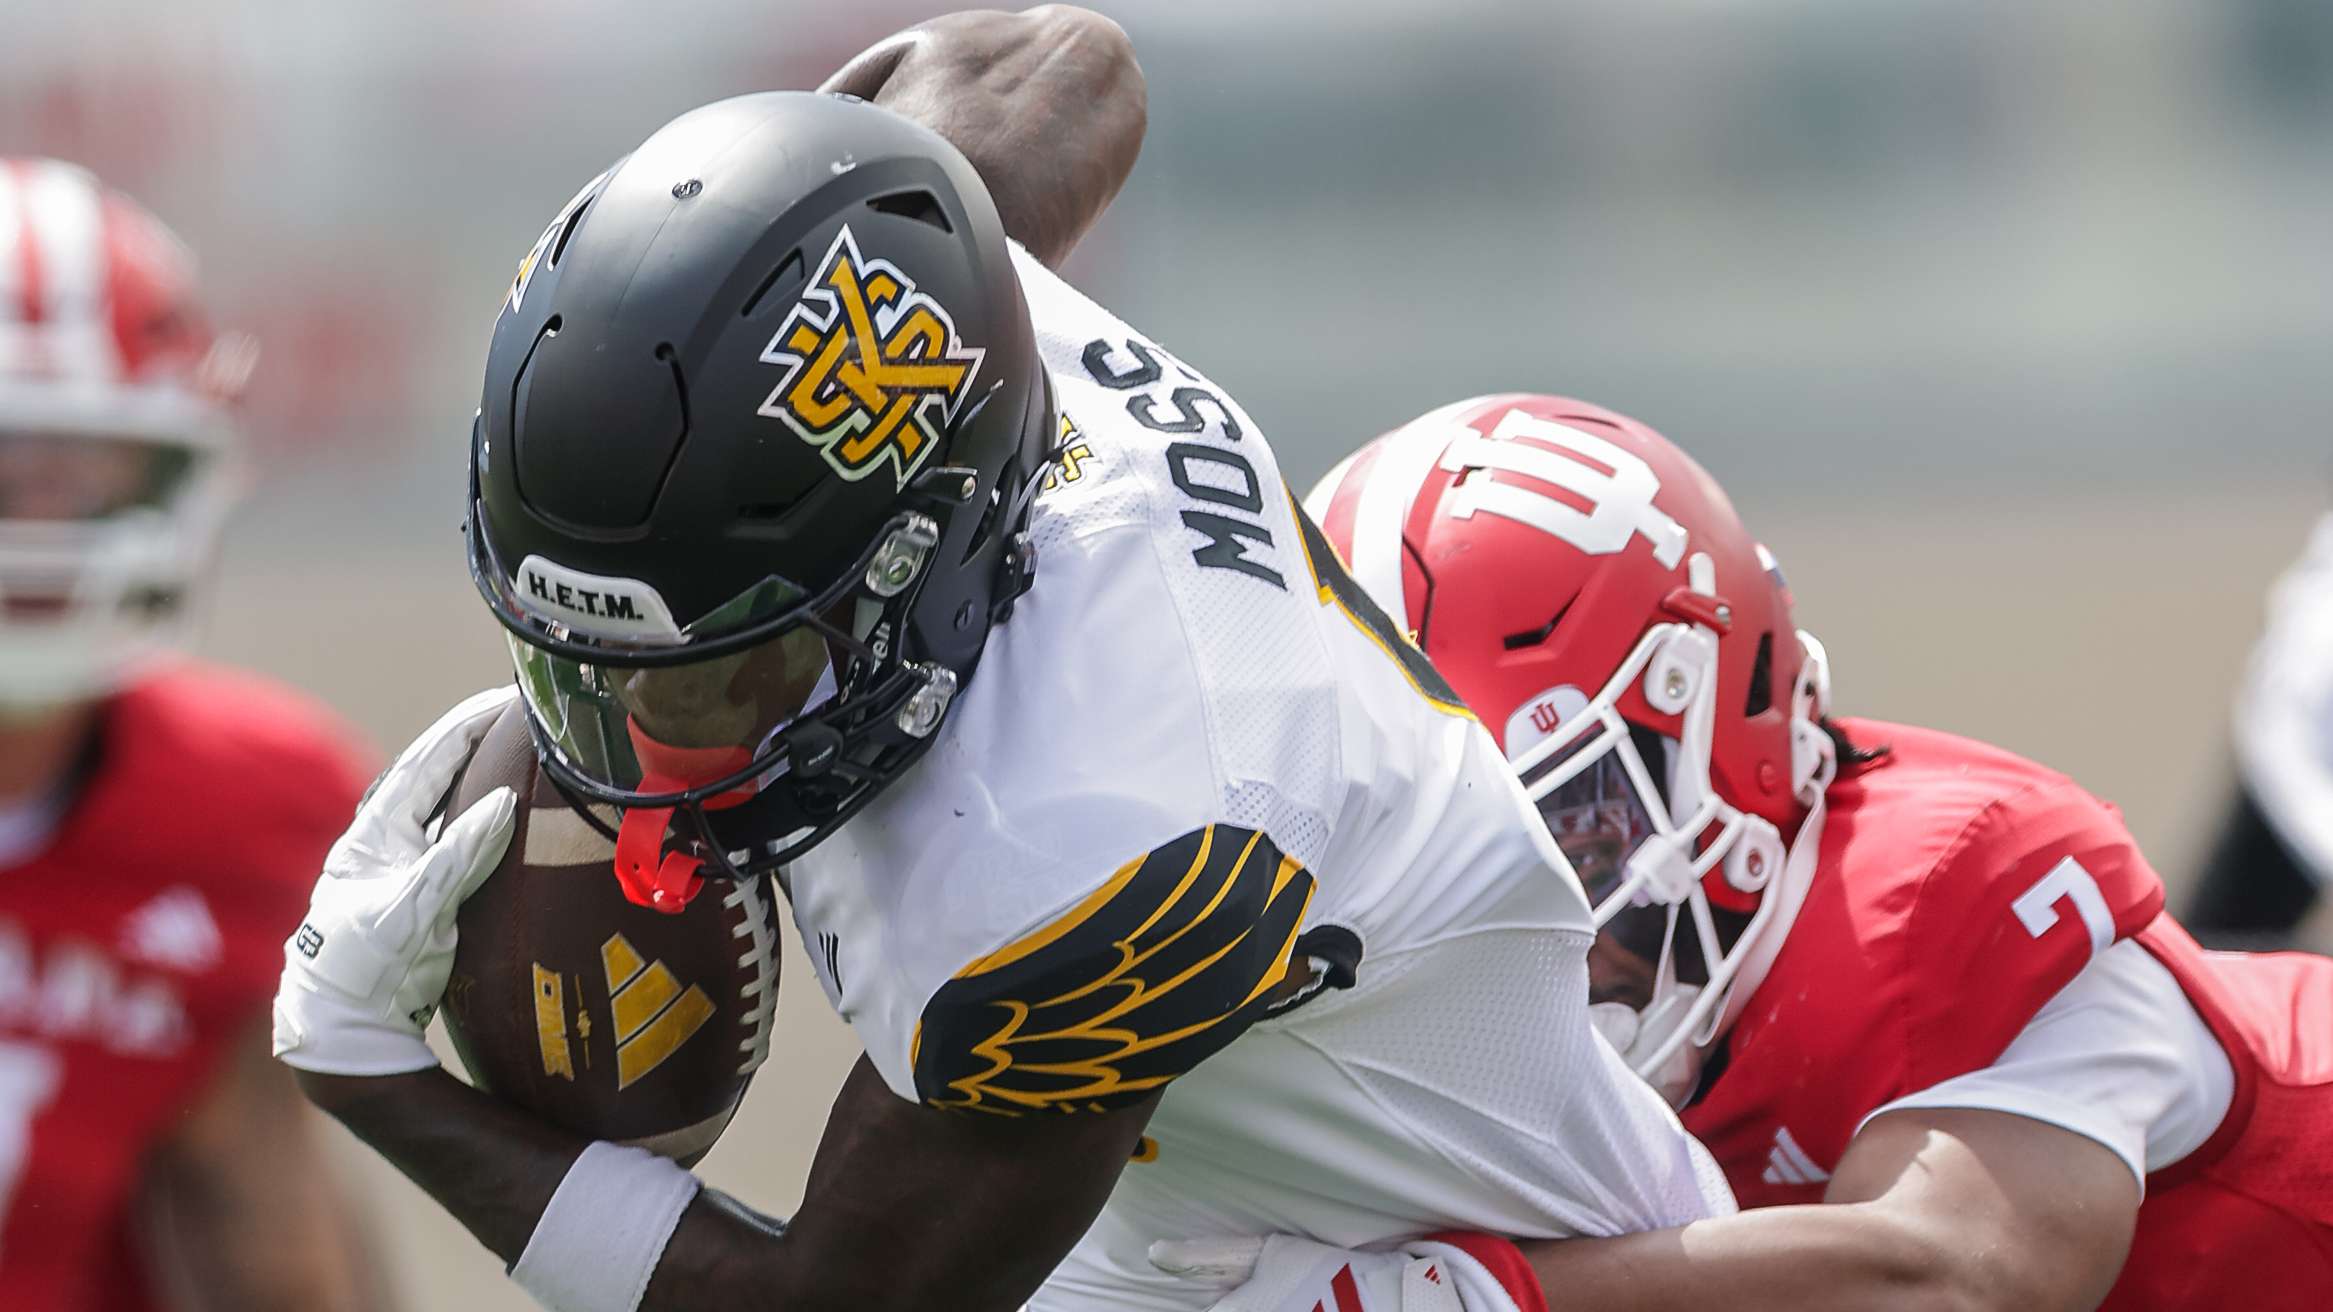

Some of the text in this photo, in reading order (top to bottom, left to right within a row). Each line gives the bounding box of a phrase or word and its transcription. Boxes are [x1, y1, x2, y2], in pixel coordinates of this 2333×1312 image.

[1081, 338, 1288, 592] MOSS
[528, 571, 644, 621] H.E.T.M.
[2010, 854, 2117, 960] 7
